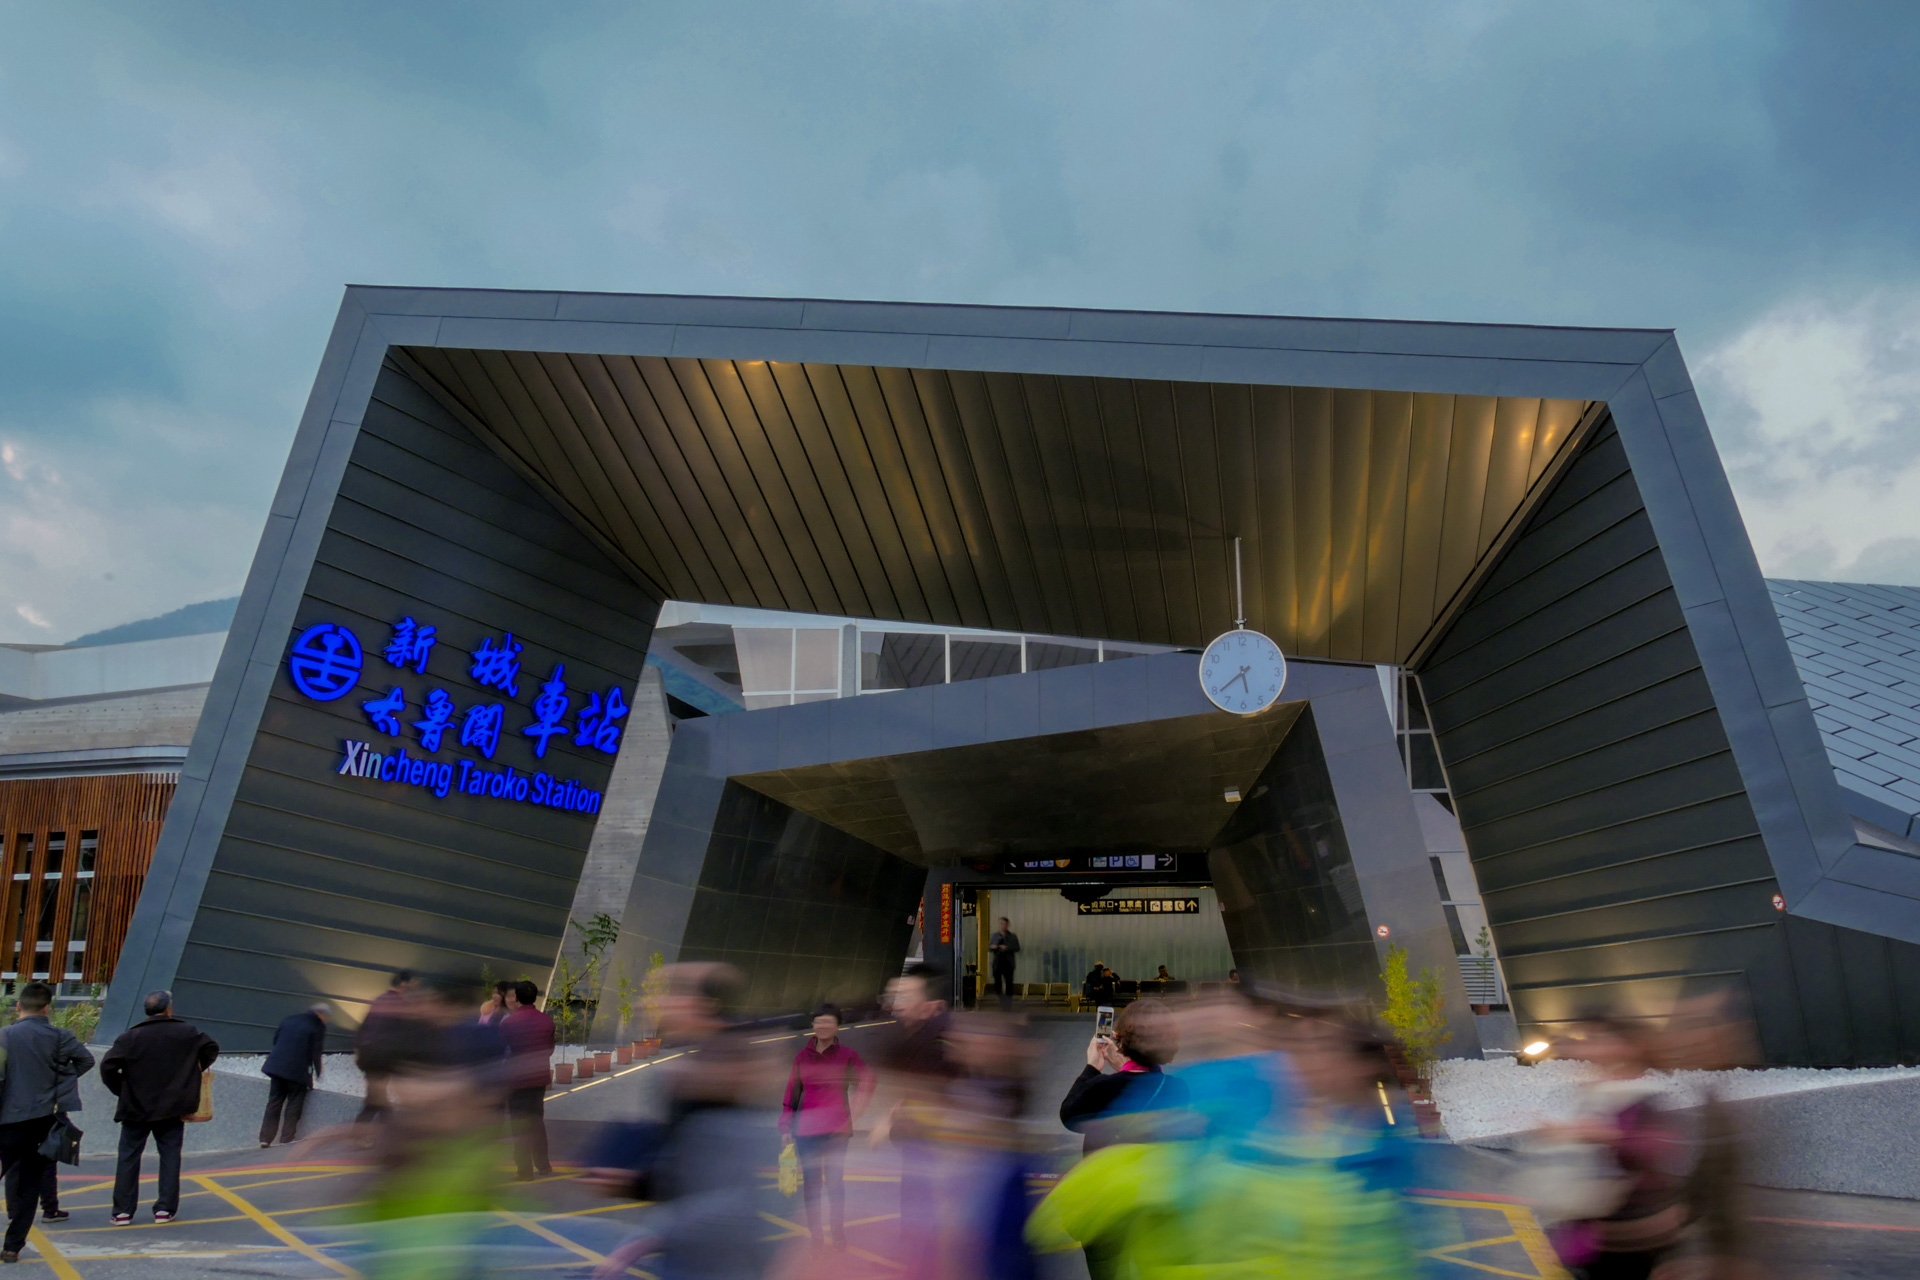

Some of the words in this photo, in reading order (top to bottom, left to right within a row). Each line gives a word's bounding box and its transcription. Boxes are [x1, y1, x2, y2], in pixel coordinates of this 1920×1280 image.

[1237, 636, 1247, 646] 12
[1223, 642, 1230, 651] 11
[384, 616, 523, 697] 新城
[1211, 654, 1220, 664] 10
[1268, 651, 1275, 660] 2
[1205, 669, 1213, 679] 9
[1274, 667, 1281, 677] 3
[1211, 686, 1218, 696] 8
[1269, 684, 1276, 693] 4
[1224, 696, 1231, 706] 7
[1240, 700, 1247, 710] 6
[1257, 696, 1264, 706] 5
[522, 664, 629, 758] 車站
[362, 686, 504, 758] 太魯閣
[337, 740, 454, 798] Xincheng
[458, 759, 529, 802] Taroko
[530, 771, 601, 815] Station
